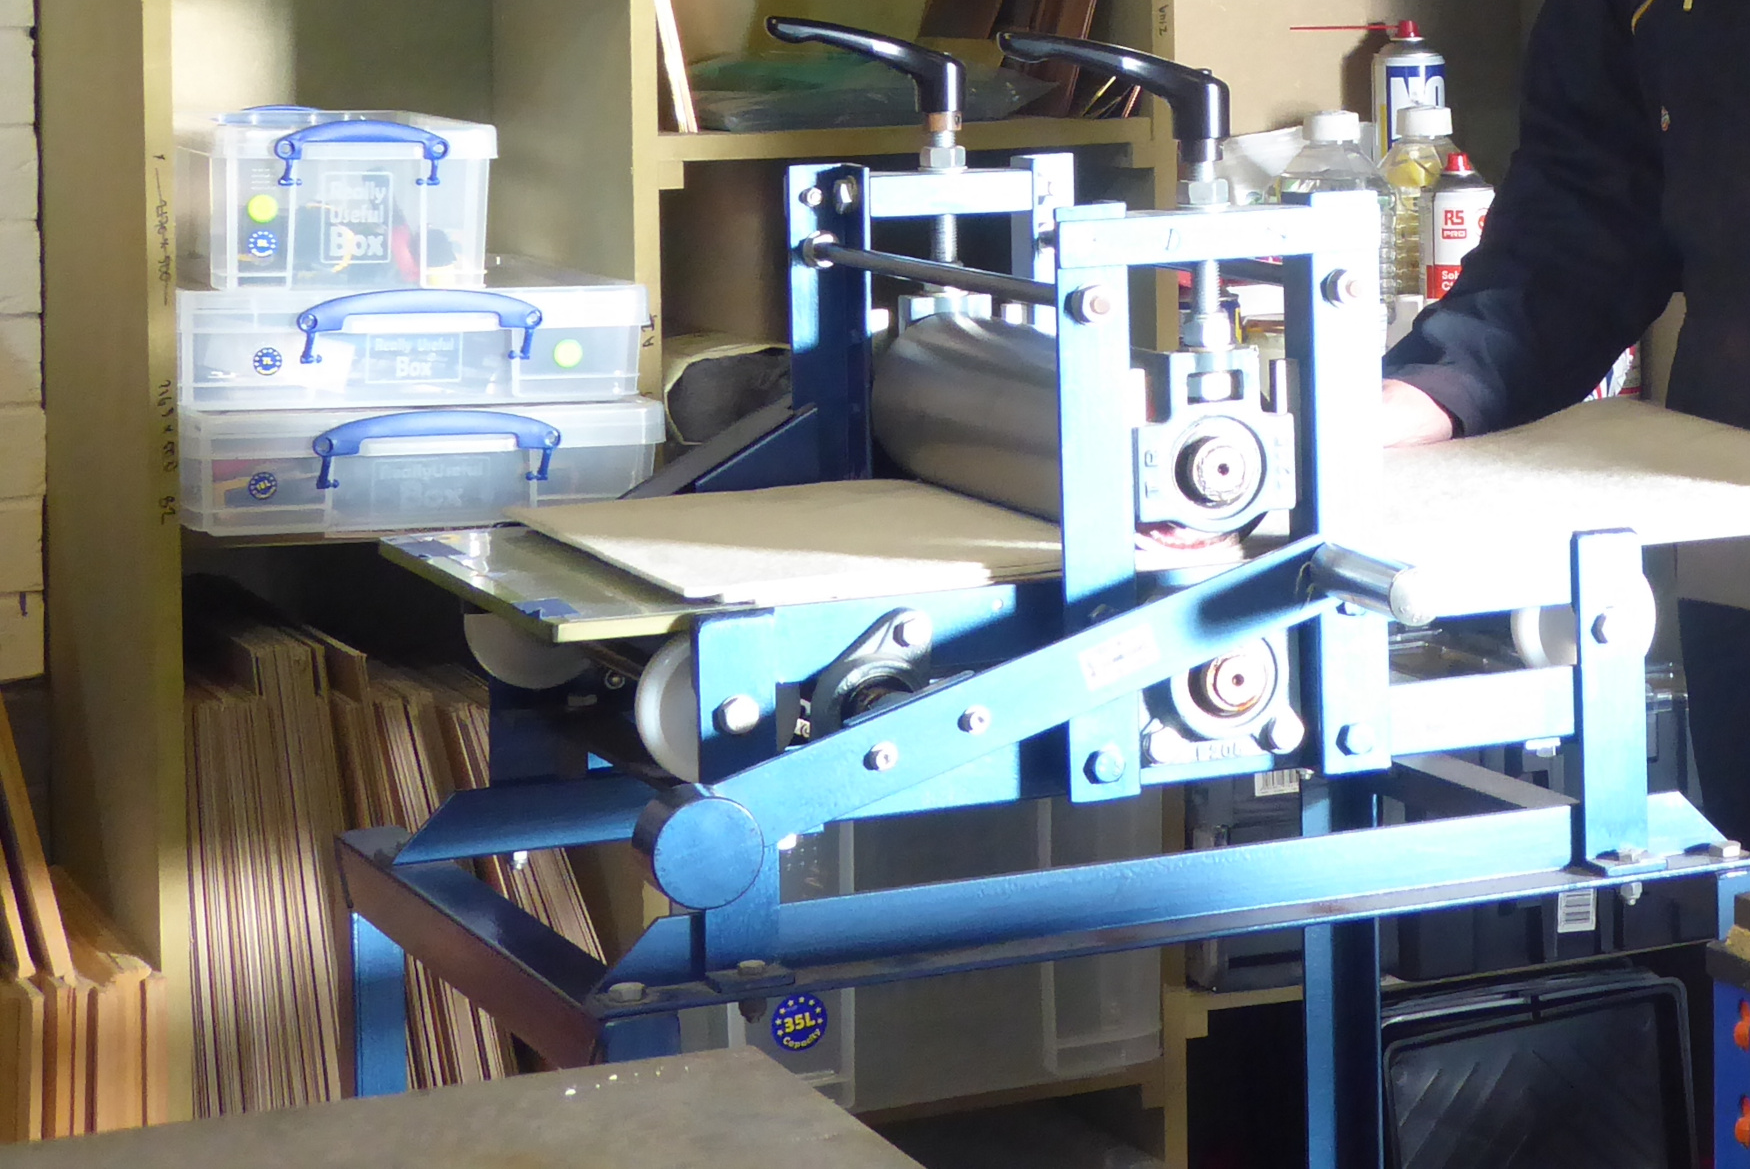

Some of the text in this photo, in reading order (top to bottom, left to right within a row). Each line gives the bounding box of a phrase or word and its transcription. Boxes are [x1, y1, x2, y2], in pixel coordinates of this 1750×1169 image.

[331, 180, 387, 204] Really
[330, 205, 384, 224] Useful
[1444, 210, 1465, 225] RS
[329, 226, 384, 258] Box
[1443, 230, 1466, 238] PRO
[374, 334, 454, 352] Really Useful
[396, 355, 433, 377] Box
[783, 1012, 816, 1033] 35L
